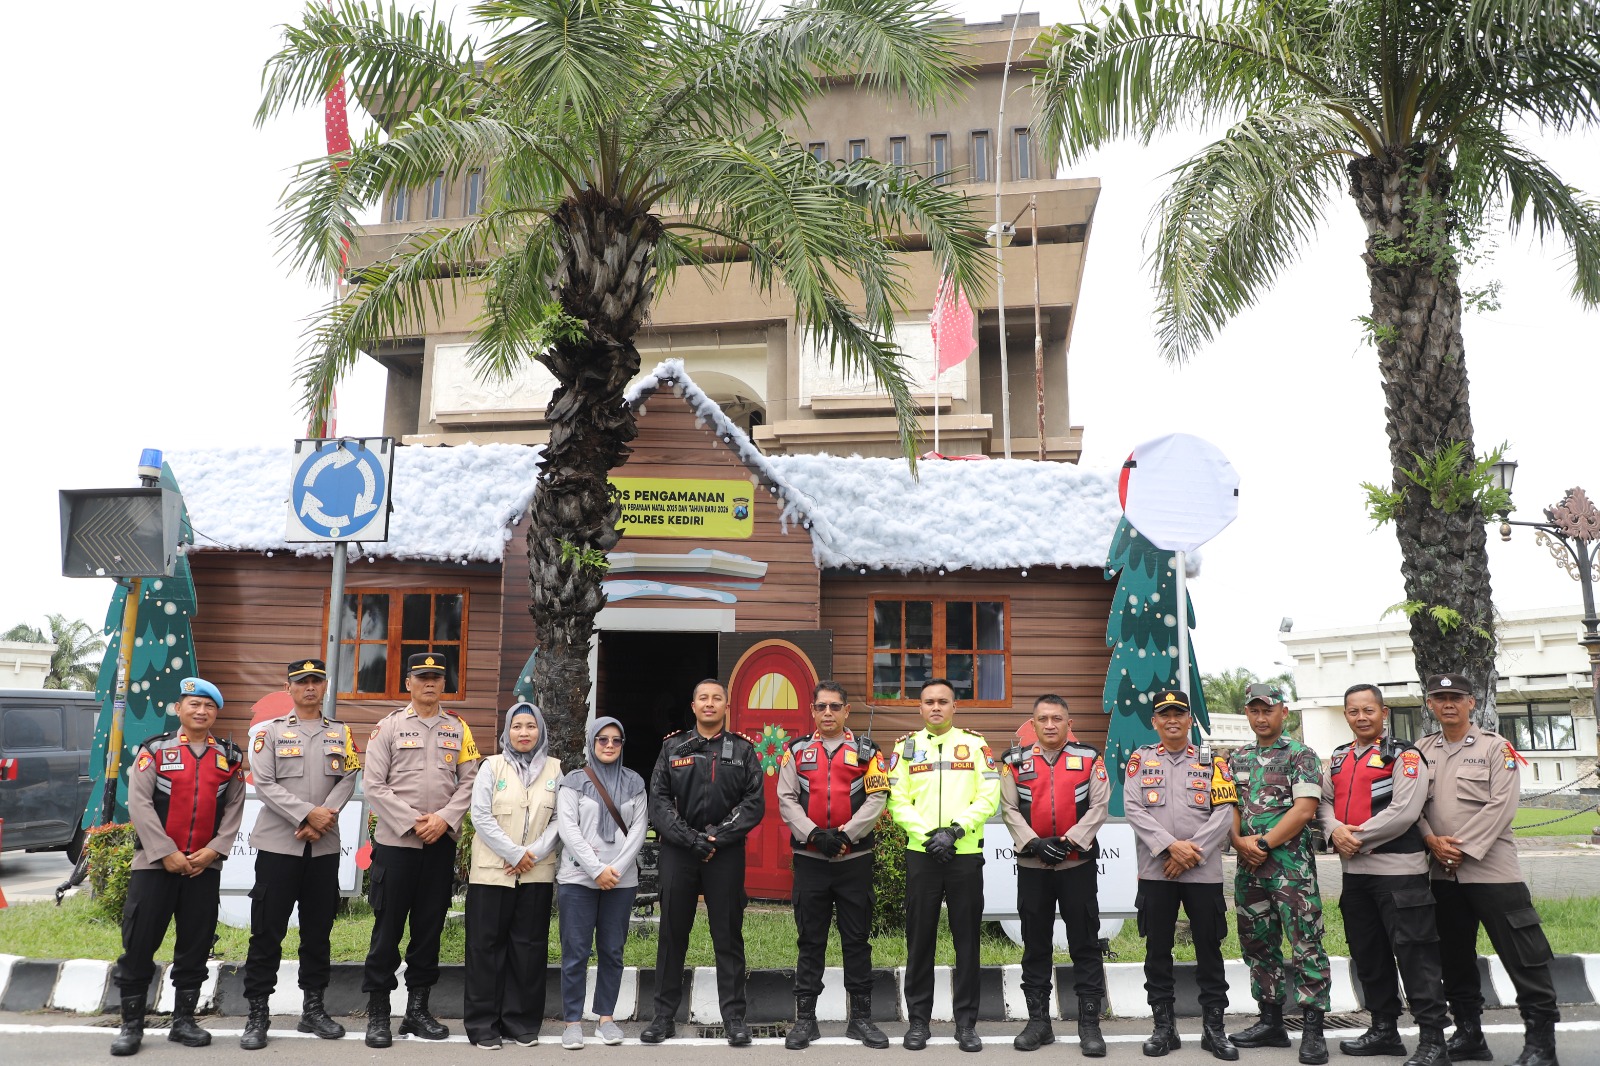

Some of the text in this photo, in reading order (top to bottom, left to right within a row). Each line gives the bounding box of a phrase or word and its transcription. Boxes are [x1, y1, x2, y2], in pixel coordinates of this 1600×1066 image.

[634, 490, 725, 503] PENGAMANAN
[651, 504, 666, 512] NATAL
[678, 505, 688, 513] DAN
[689, 505, 704, 513] TAHUN
[704, 505, 717, 513] BARU
[622, 514, 704, 526] POLRES KEDIRI
[674, 758, 691, 766] BRAM
[1187, 771, 1210, 779] POLRI
